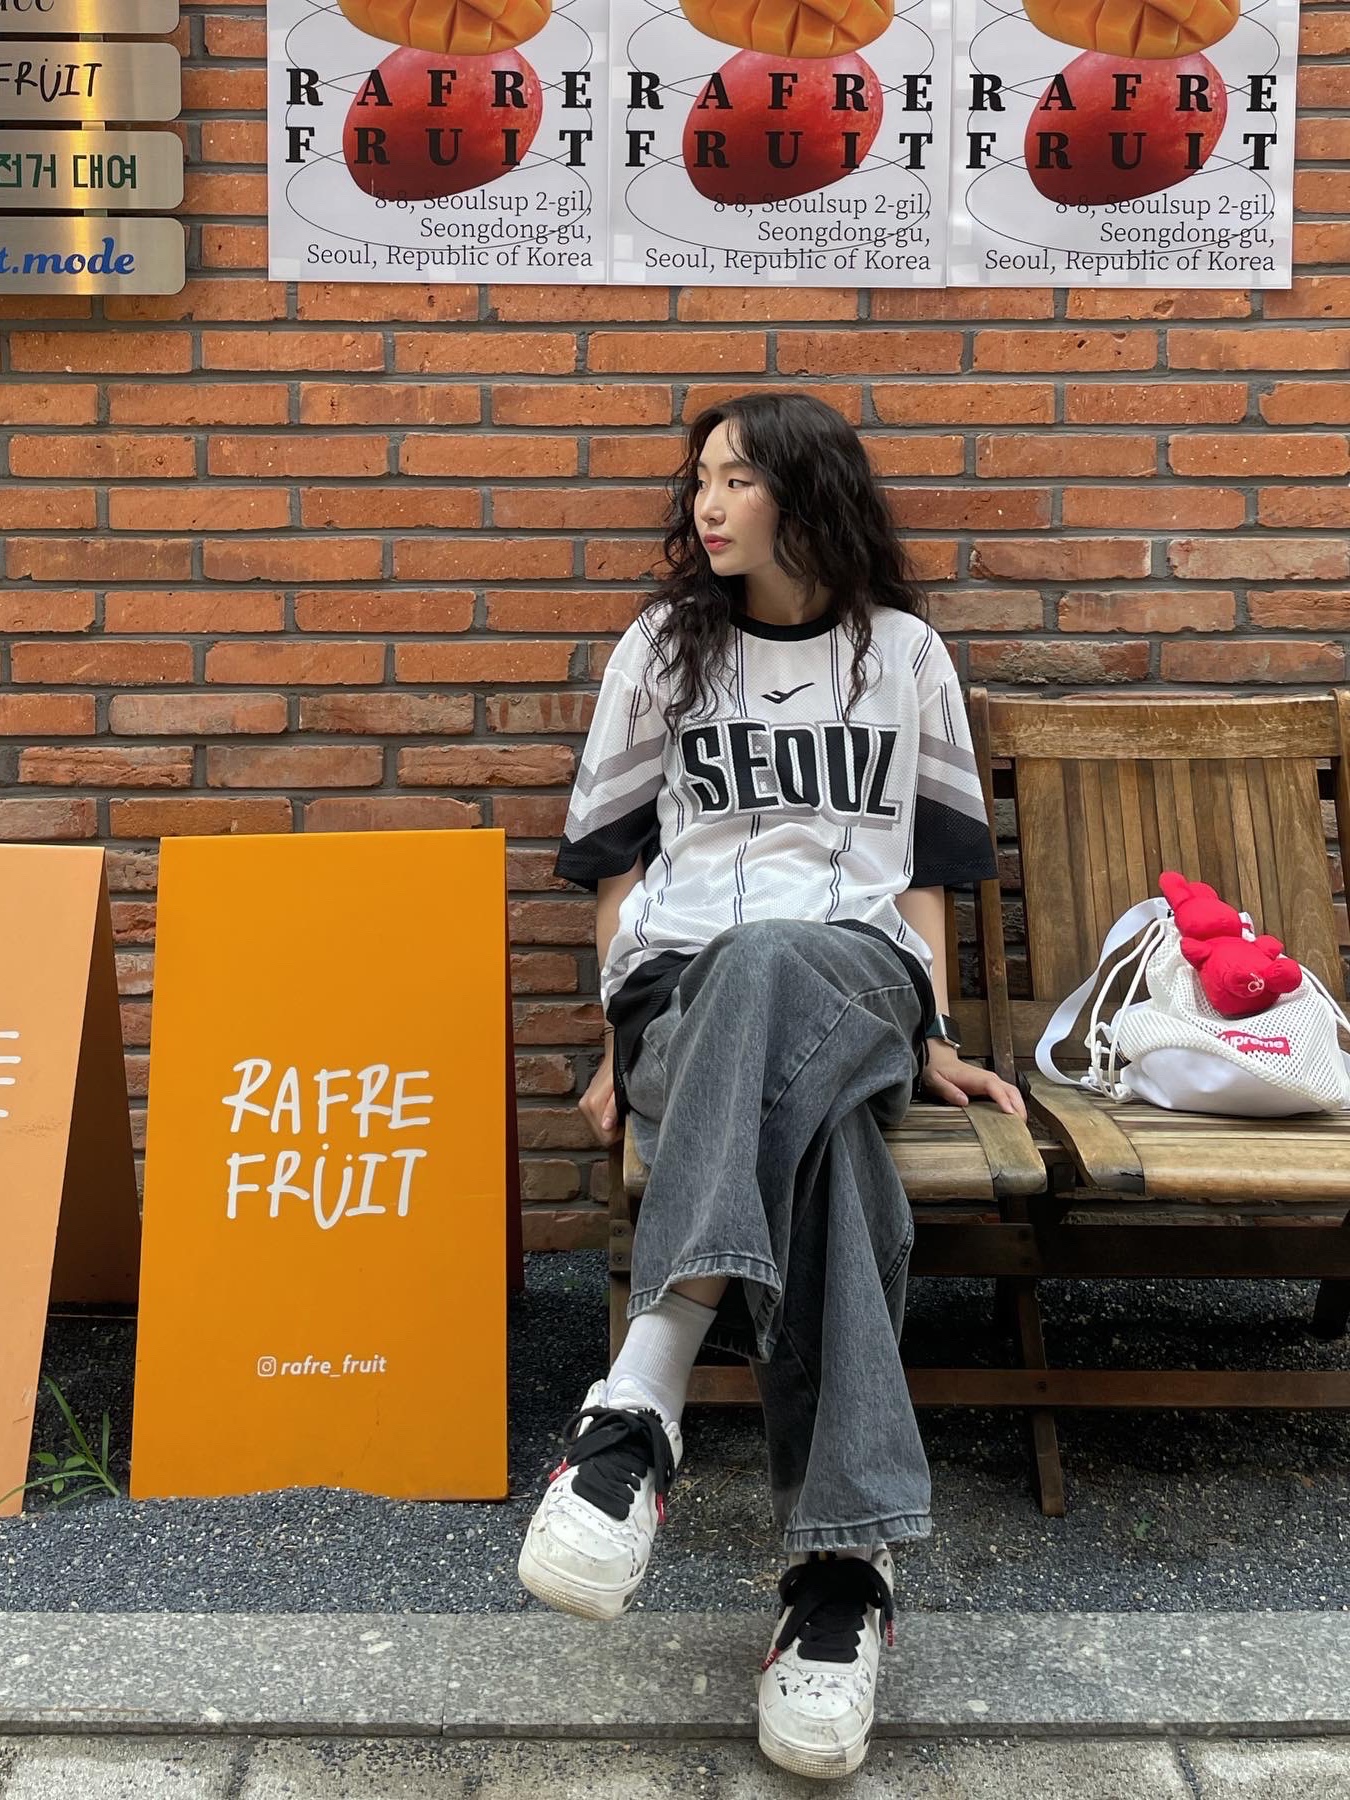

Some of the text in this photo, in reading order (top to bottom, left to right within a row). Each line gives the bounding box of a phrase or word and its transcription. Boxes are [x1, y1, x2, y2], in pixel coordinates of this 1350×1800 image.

[73, 154, 137, 189] 대여
[423, 190, 528, 216] Seoulsup
[535, 190, 592, 216] 2-gil,
[761, 193, 867, 219] Seoulsup
[874, 194, 931, 220] 2-gil,
[1104, 194, 1211, 220] Seoulsup
[1217, 194, 1275, 221] 2-gil,
[420, 218, 592, 244] Seongdong-gu,
[758, 220, 930, 247] Seongdong-gu,
[1100, 222, 1275, 248] Seongdong-gu,
[307, 244, 593, 271] Seoul, Republic of Korea
[645, 247, 931, 275] Seoul, Republic of Korea
[985, 249, 1275, 276] Seoul, Republic of Korea
[678, 719, 902, 826] SEOUL
[222, 1058, 434, 1139] RAFRE
[280, 1353, 388, 1378] rafre_fruit
